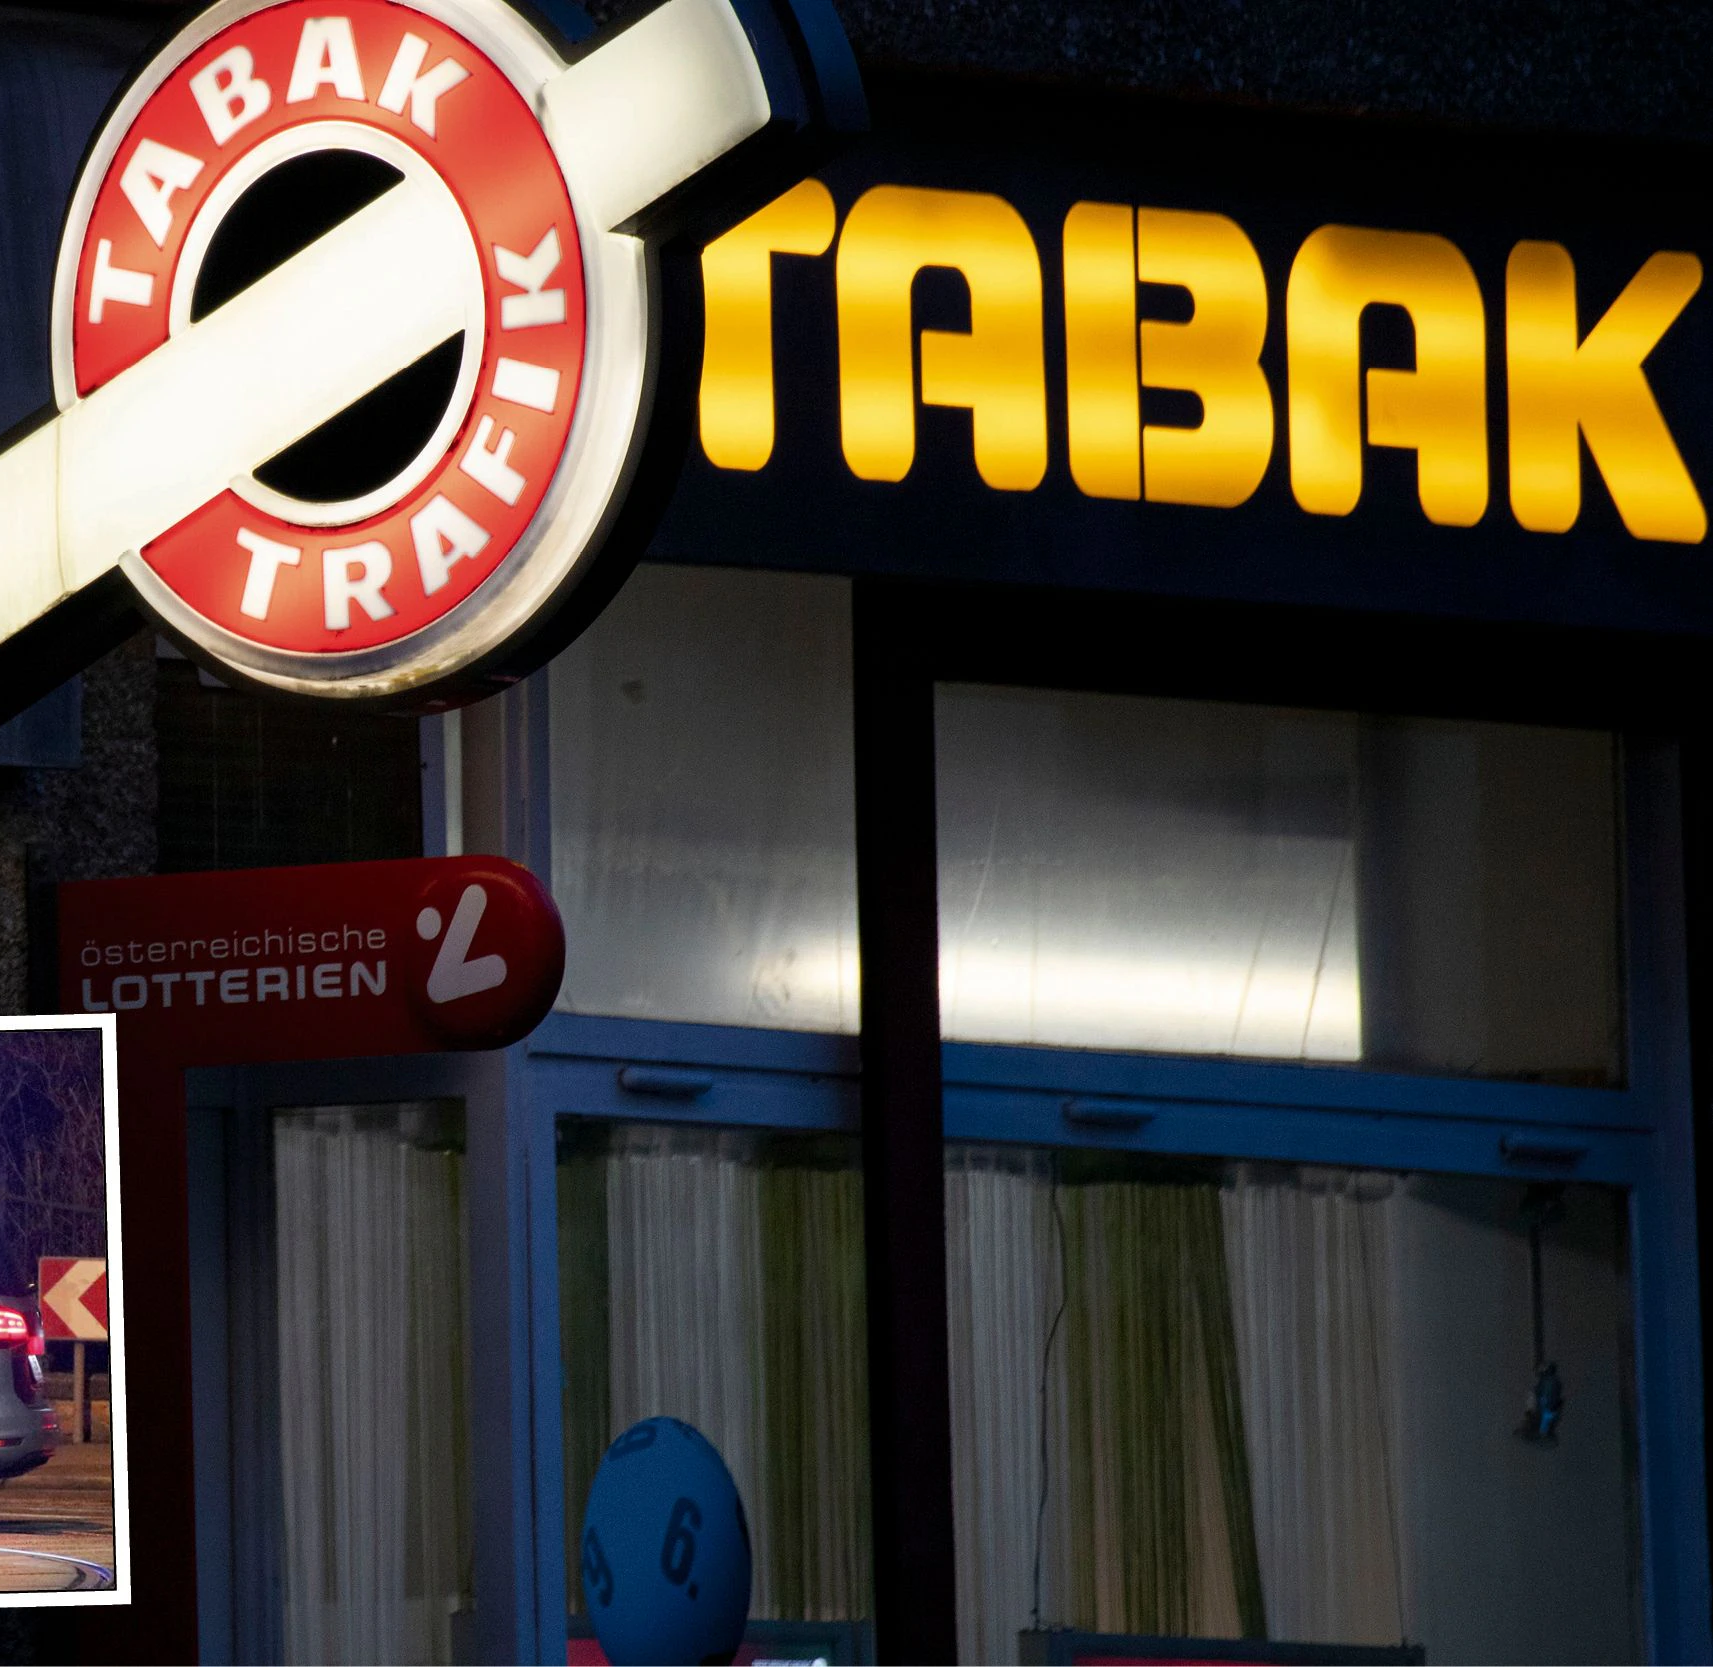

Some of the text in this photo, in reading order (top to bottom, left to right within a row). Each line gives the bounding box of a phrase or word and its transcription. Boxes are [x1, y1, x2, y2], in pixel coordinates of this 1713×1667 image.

[89, 15, 472, 325] TABAK
[235, 223, 567, 631] TRAFIK
[698, 177, 1709, 545] TABAK
[80, 922, 388, 967] österreichische
[80, 960, 388, 1012] LOTTERIEN
